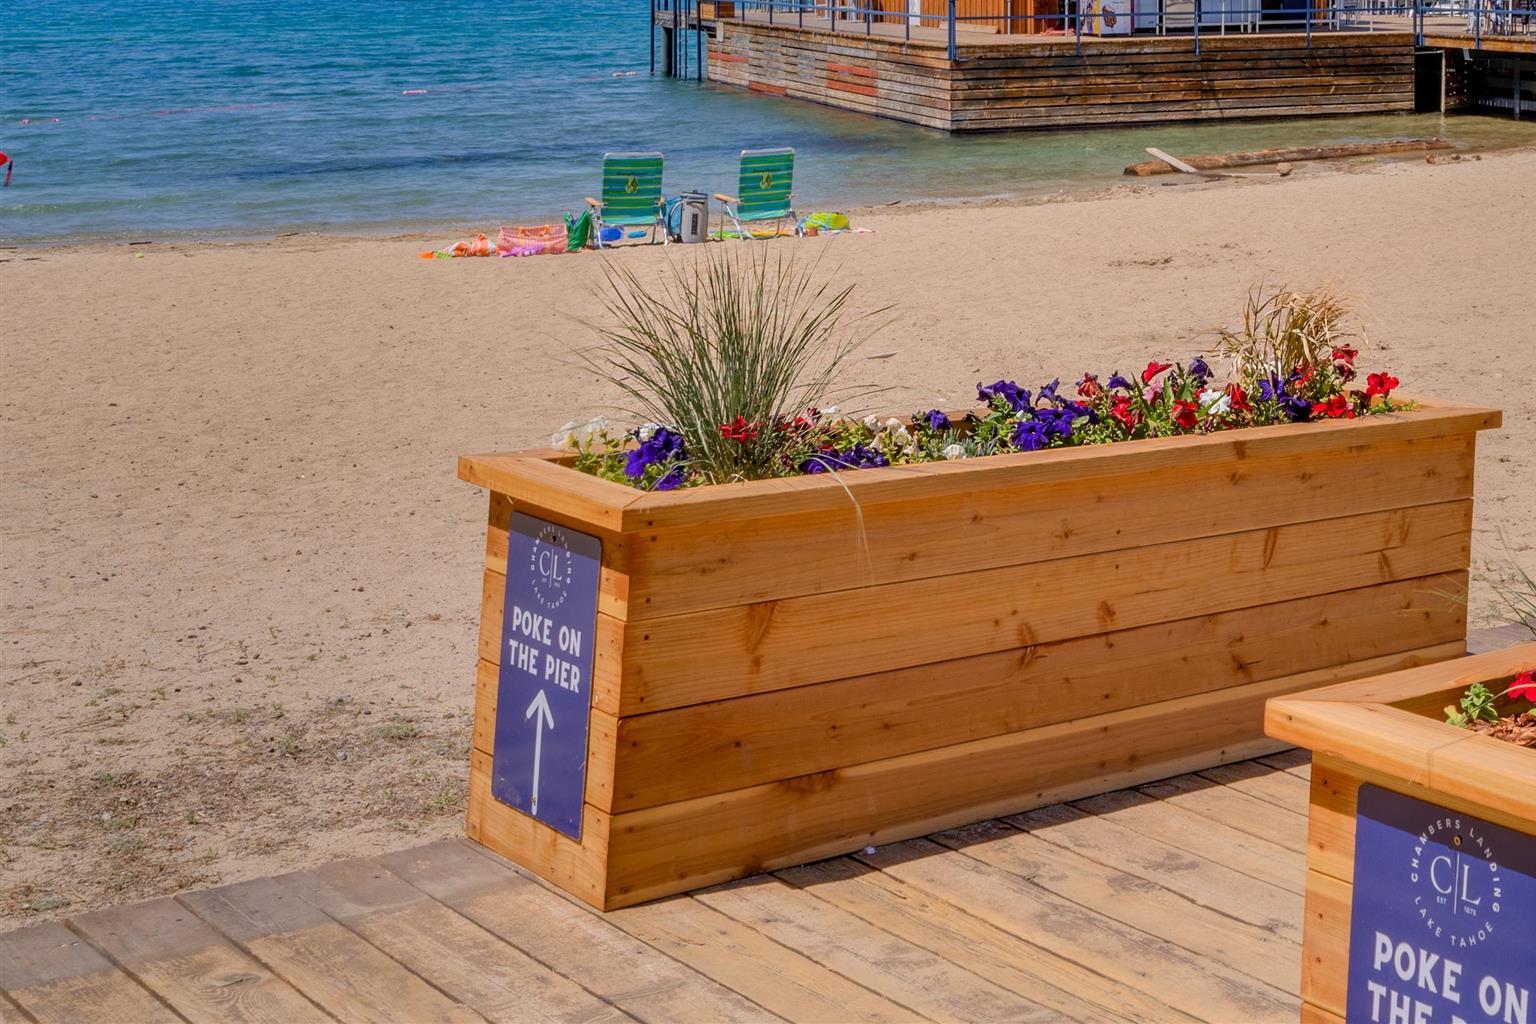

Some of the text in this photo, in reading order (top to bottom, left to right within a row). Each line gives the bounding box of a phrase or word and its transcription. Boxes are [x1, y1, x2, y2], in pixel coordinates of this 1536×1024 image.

[512, 605, 582, 658] POKE ON
[508, 638, 581, 694] THE PIER
[1411, 818, 1501, 913] CHAMBERS LANDING
[1414, 896, 1493, 948] LAKE TAHOE
[1367, 980, 1433, 1024] THE
[1373, 931, 1529, 1024] POKE ON
